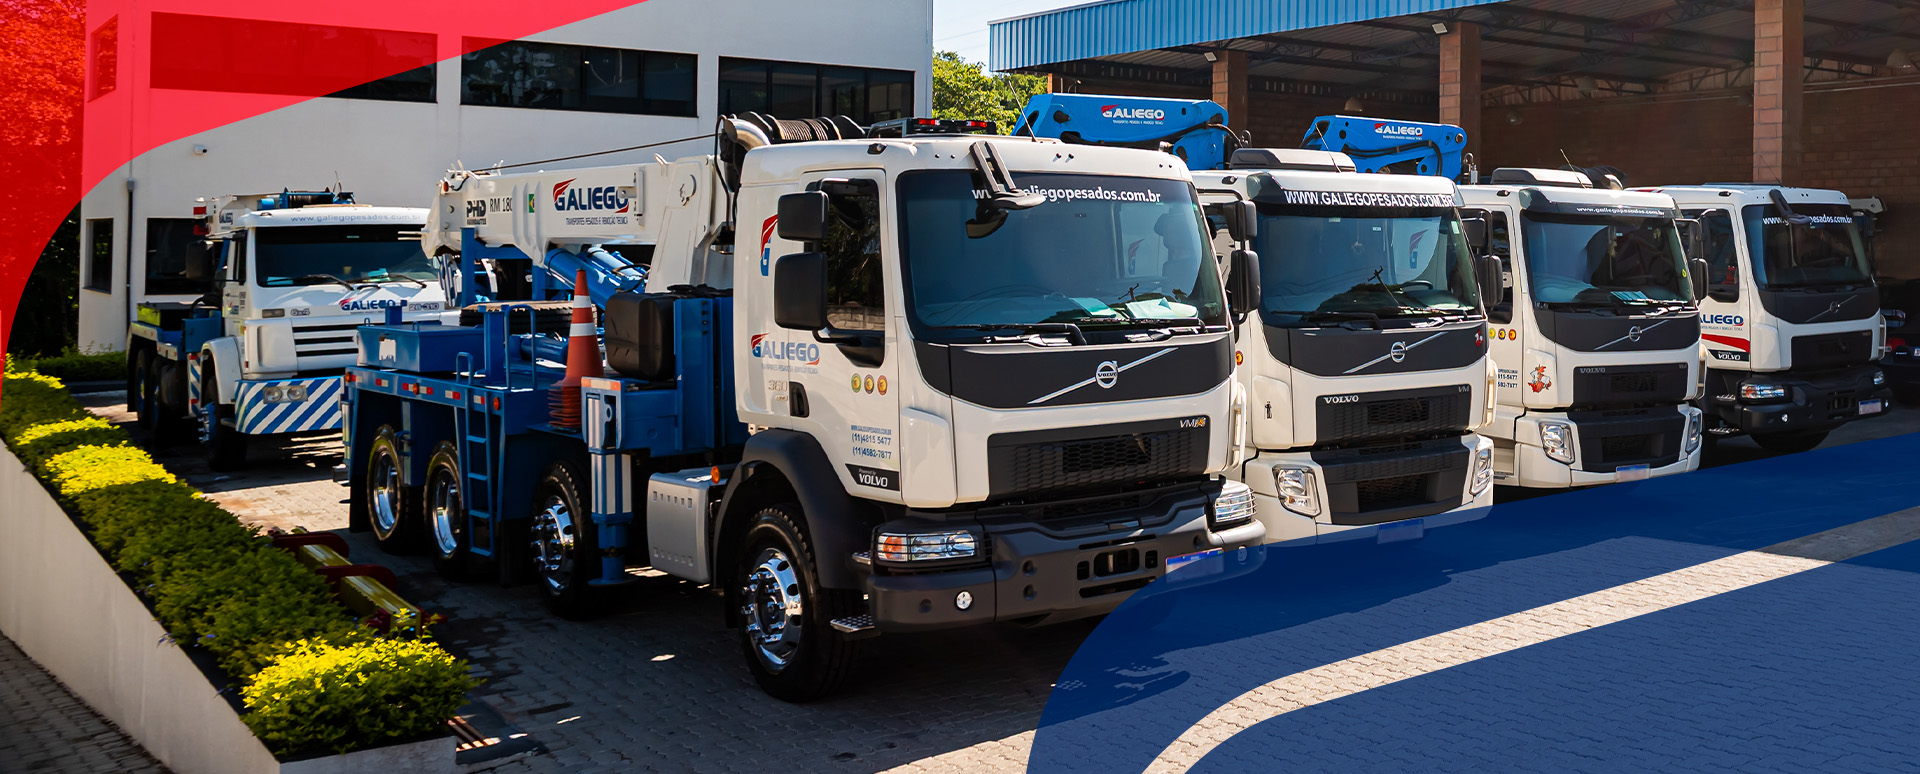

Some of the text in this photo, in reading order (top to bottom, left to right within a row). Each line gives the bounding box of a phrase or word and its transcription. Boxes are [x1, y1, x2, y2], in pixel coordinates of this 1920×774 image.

[1101, 106, 1164, 120] GALIEGO
[1375, 124, 1422, 136] GALIEGO
[553, 181, 629, 213] GALIEGO
[490, 198, 500, 212] RM
[340, 298, 396, 310] GALIEO
[751, 337, 819, 364] GALIEGO
[1323, 395, 1359, 404] VOLVO
[859, 473, 888, 487] VOLVO
